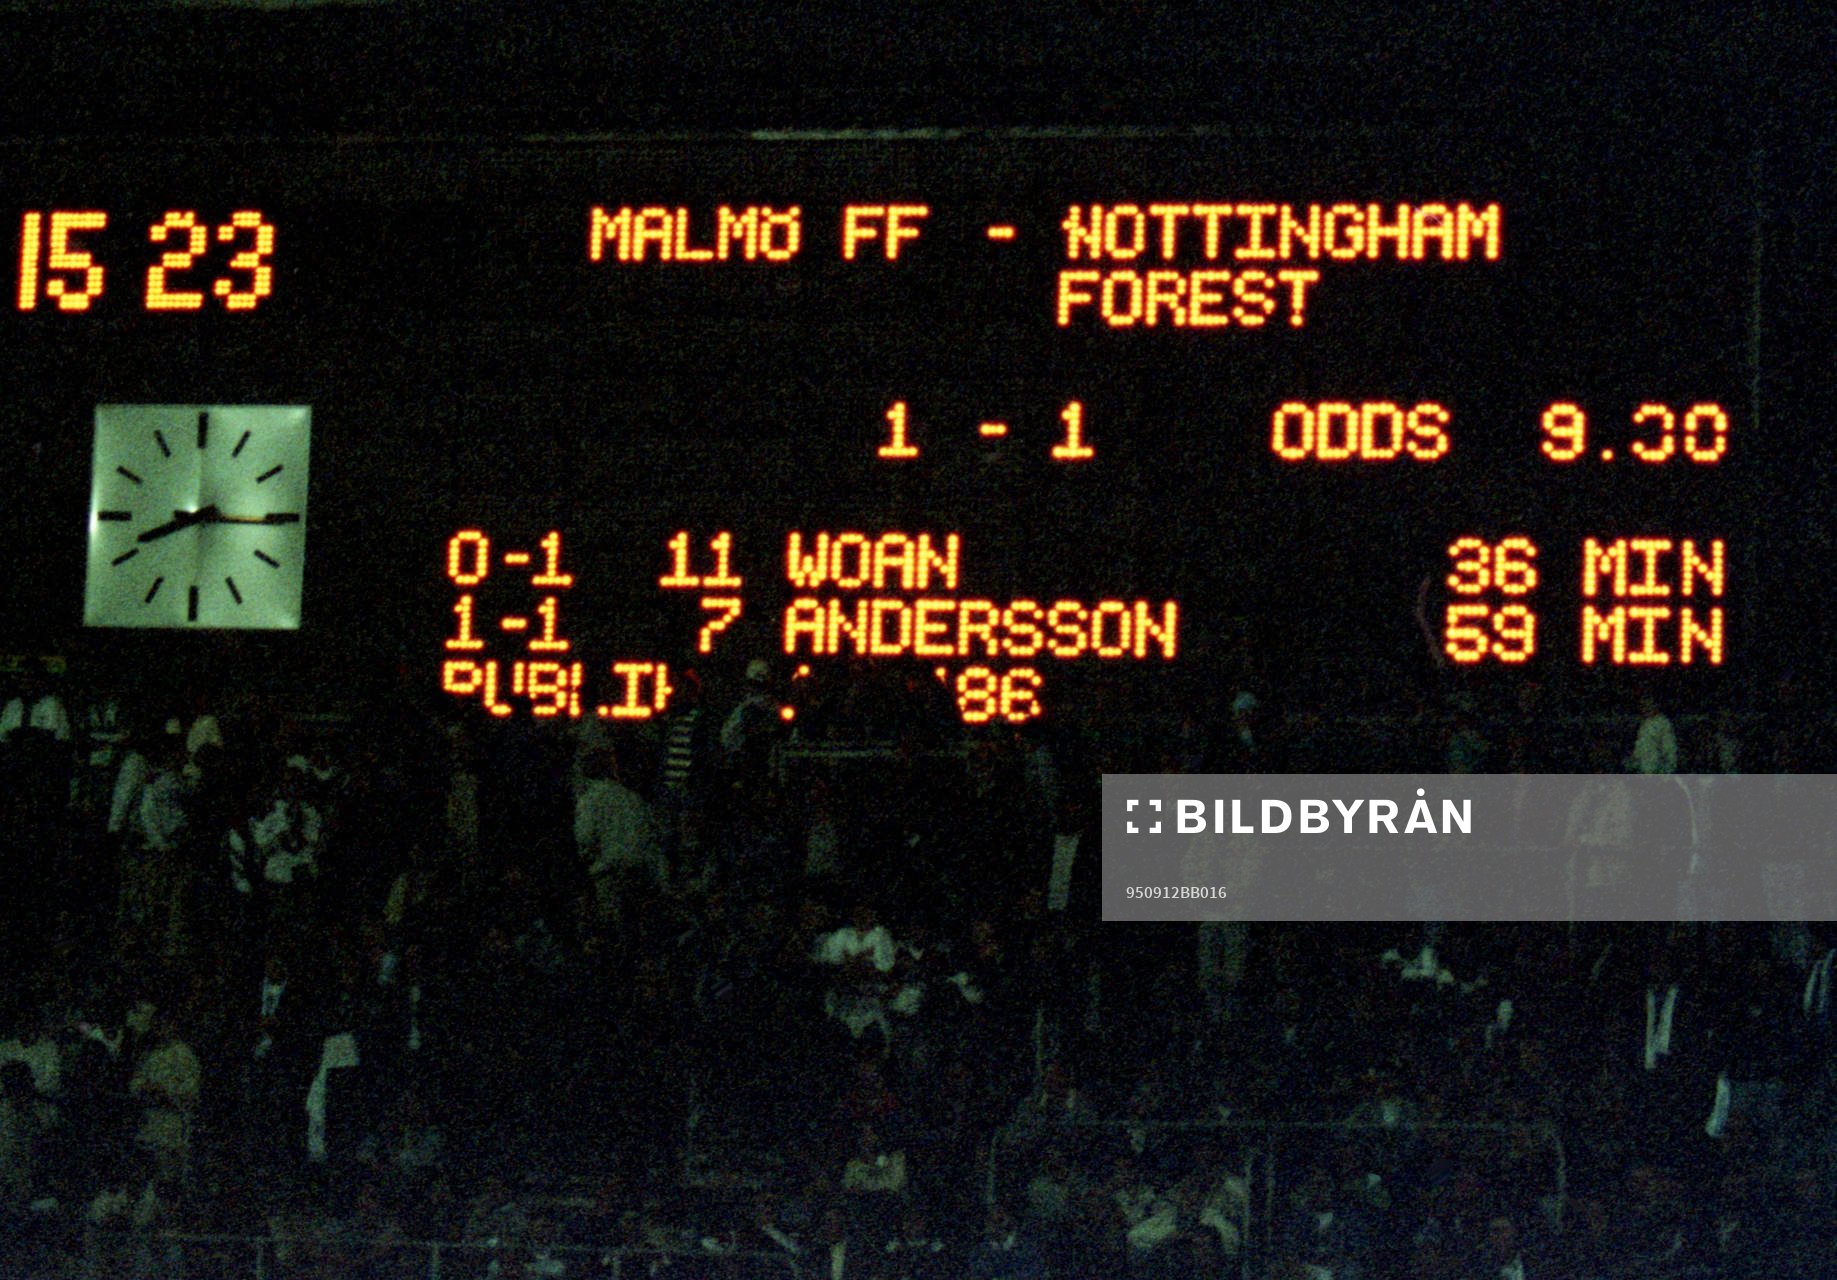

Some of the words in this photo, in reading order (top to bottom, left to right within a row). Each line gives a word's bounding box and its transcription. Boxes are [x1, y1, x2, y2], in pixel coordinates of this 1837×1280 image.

[145, 210, 275, 311] 23
[589, 204, 801, 262] MALMÖ
[842, 203, 930, 261] FF
[987, 225, 1016, 240] -
[1061, 202, 1502, 262] NOTTINGHAM
[1056, 268, 1321, 328] FOREST
[877, 401, 919, 459] 1
[979, 422, 1008, 437] -
[1051, 401, 1095, 460] 1
[1270, 400, 1451, 462] ODDS
[447, 529, 573, 587] 0-1
[659, 530, 743, 589] 11
[785, 531, 961, 591] WOAN
[1446, 536, 1538, 597] 36
[1581, 537, 1725, 598] MIN
[445, 594, 570, 652] 1-1
[698, 596, 743, 654] 7
[782, 596, 1179, 659] ANDERSSON
[1444, 603, 1537, 664] 59
[1581, 604, 1724, 666] MIN
